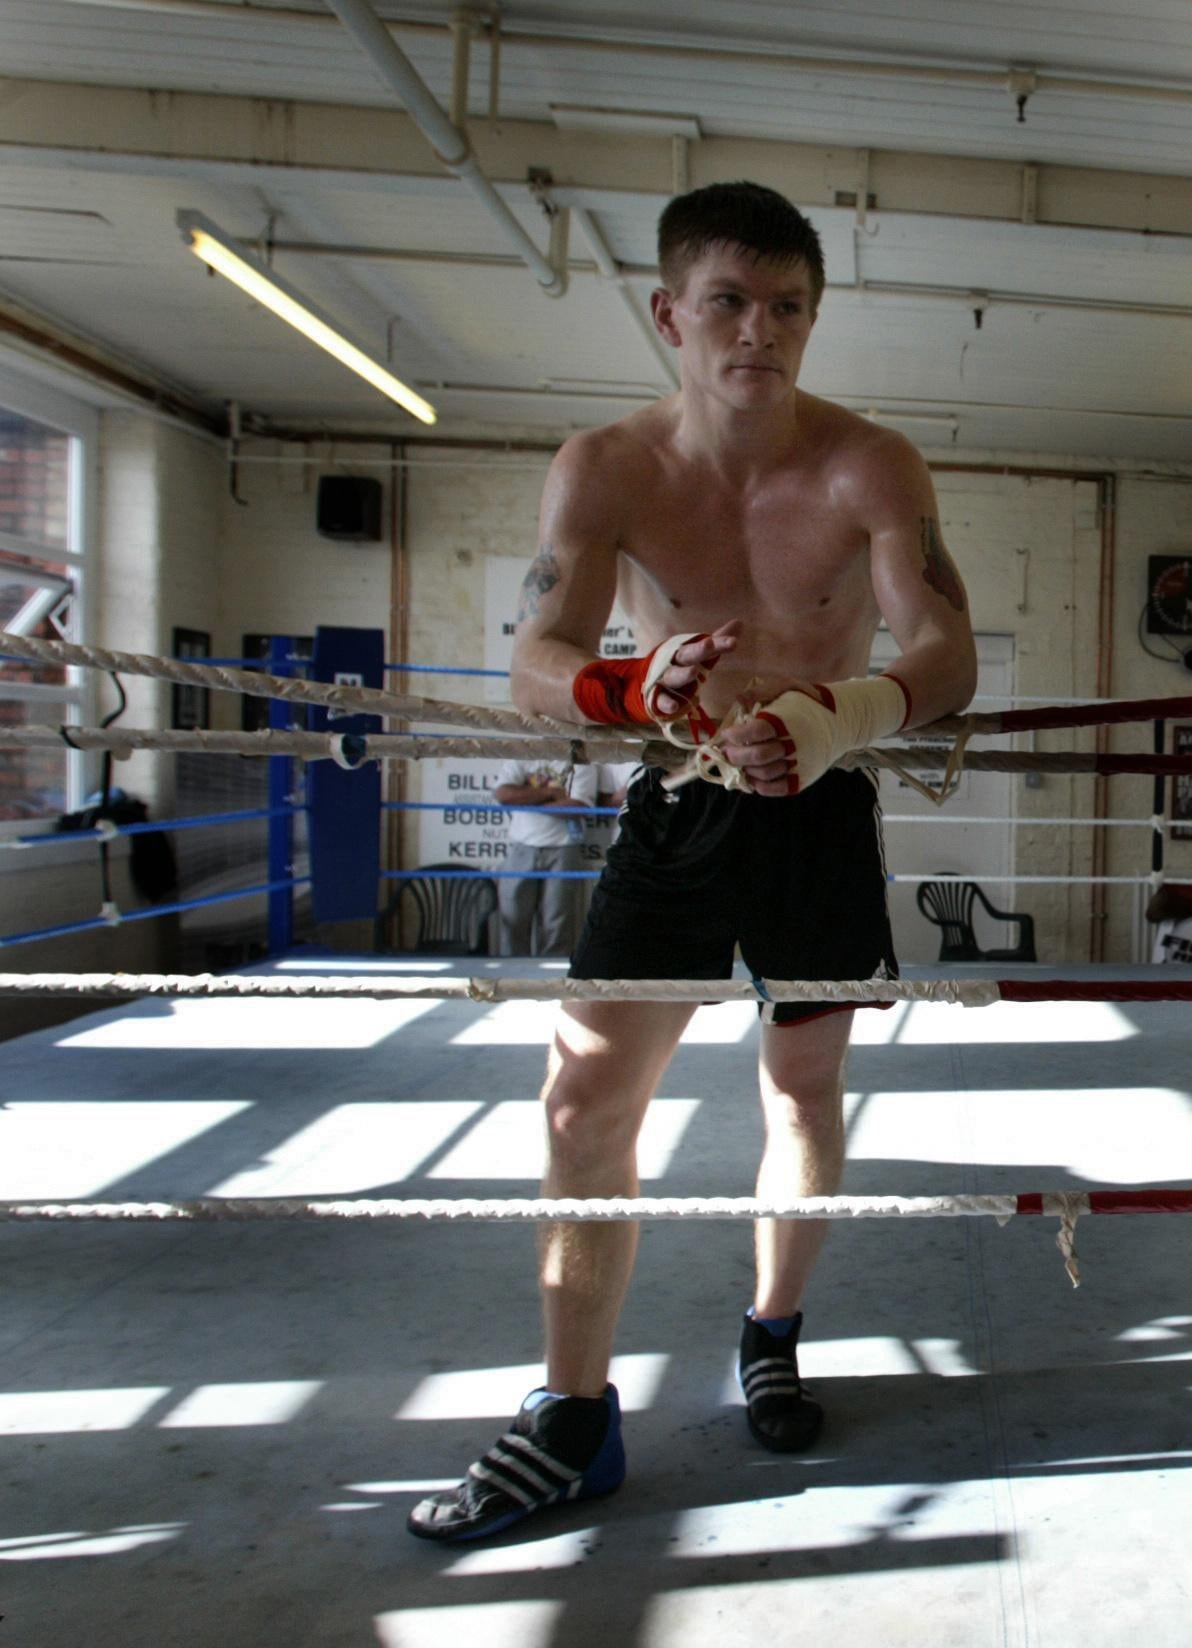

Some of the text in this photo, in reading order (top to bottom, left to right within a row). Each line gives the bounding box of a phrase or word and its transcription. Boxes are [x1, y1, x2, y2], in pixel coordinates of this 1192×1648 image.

[604, 643, 637, 656] CAMP
[448, 774, 498, 791] BILL
[449, 841, 513, 858] KERR
